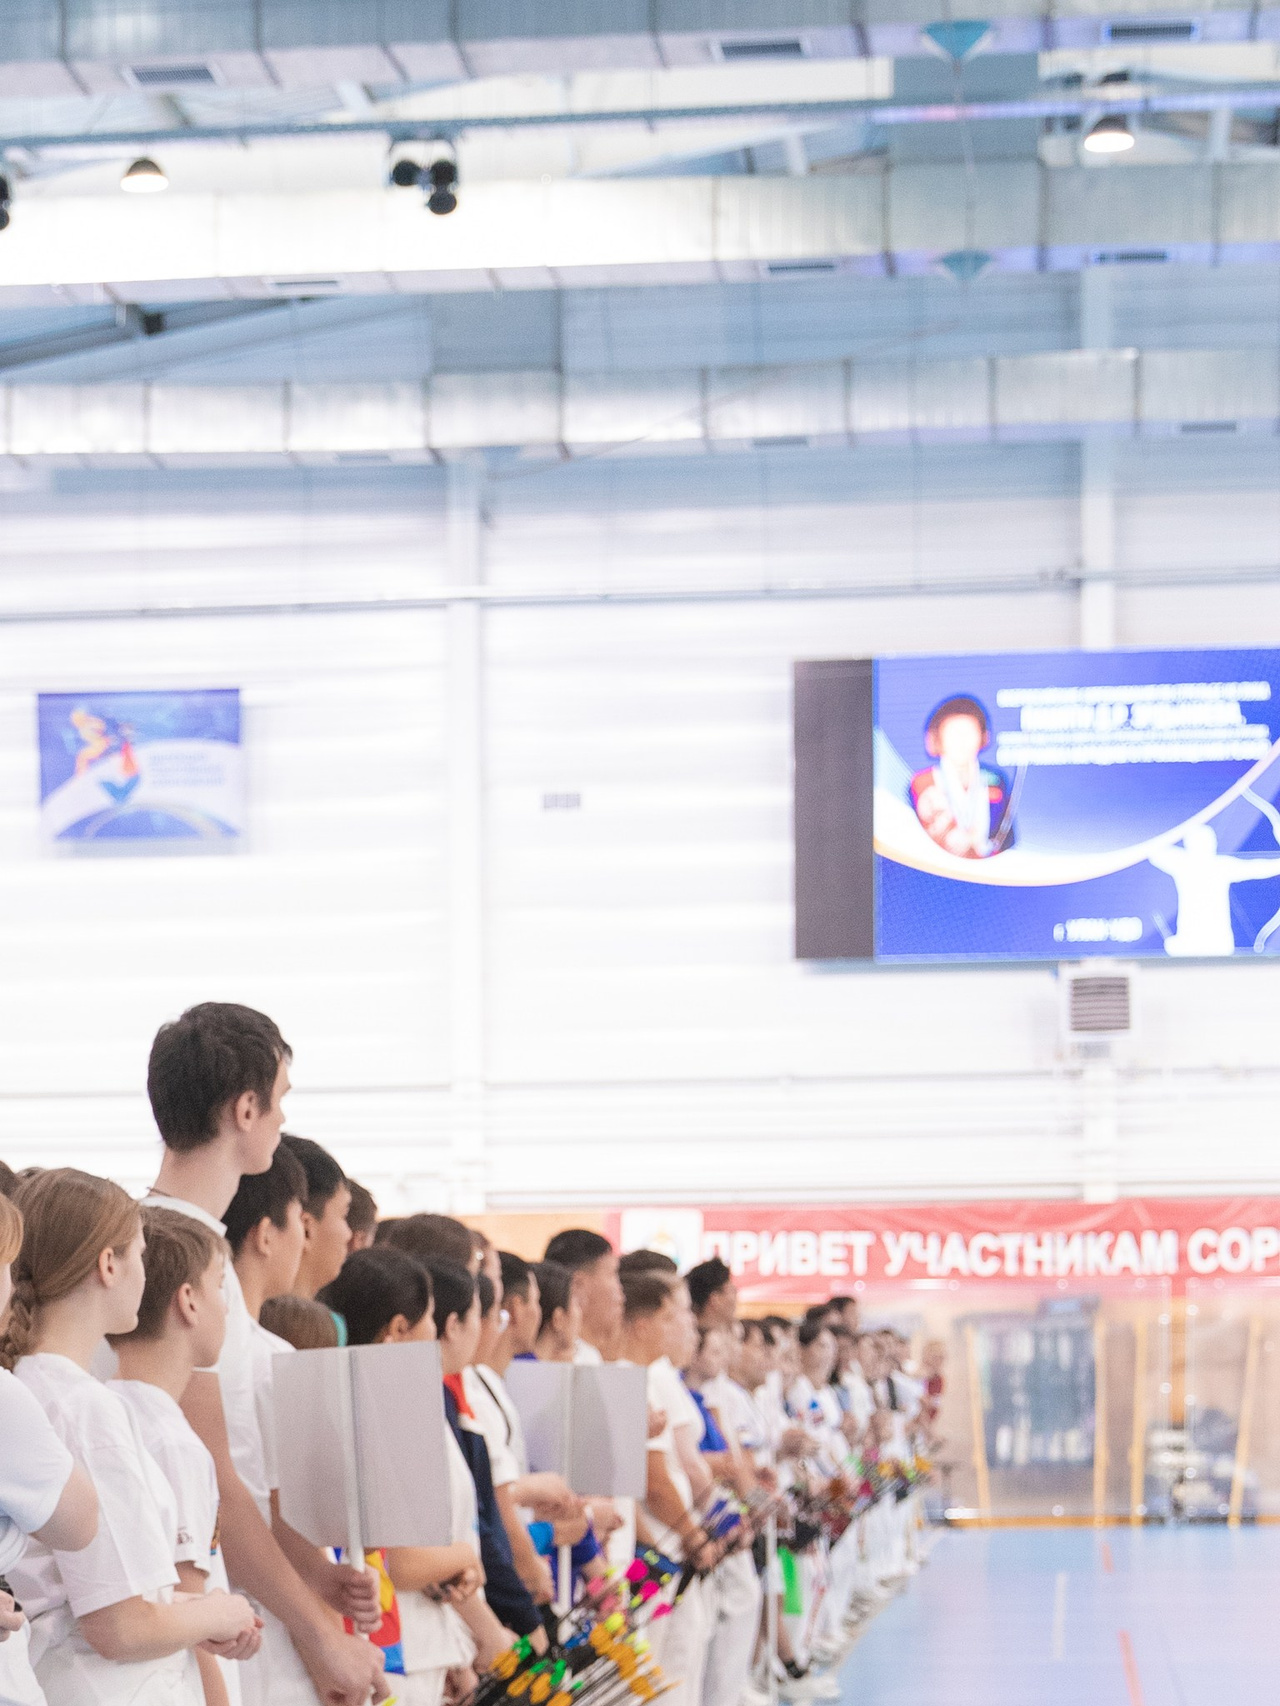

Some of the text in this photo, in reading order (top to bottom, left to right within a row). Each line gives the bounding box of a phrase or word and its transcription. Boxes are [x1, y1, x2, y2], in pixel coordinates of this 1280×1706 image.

[703, 1226, 1280, 1277] ПРИВЕТ УЧАСТНИКАМ СОР
